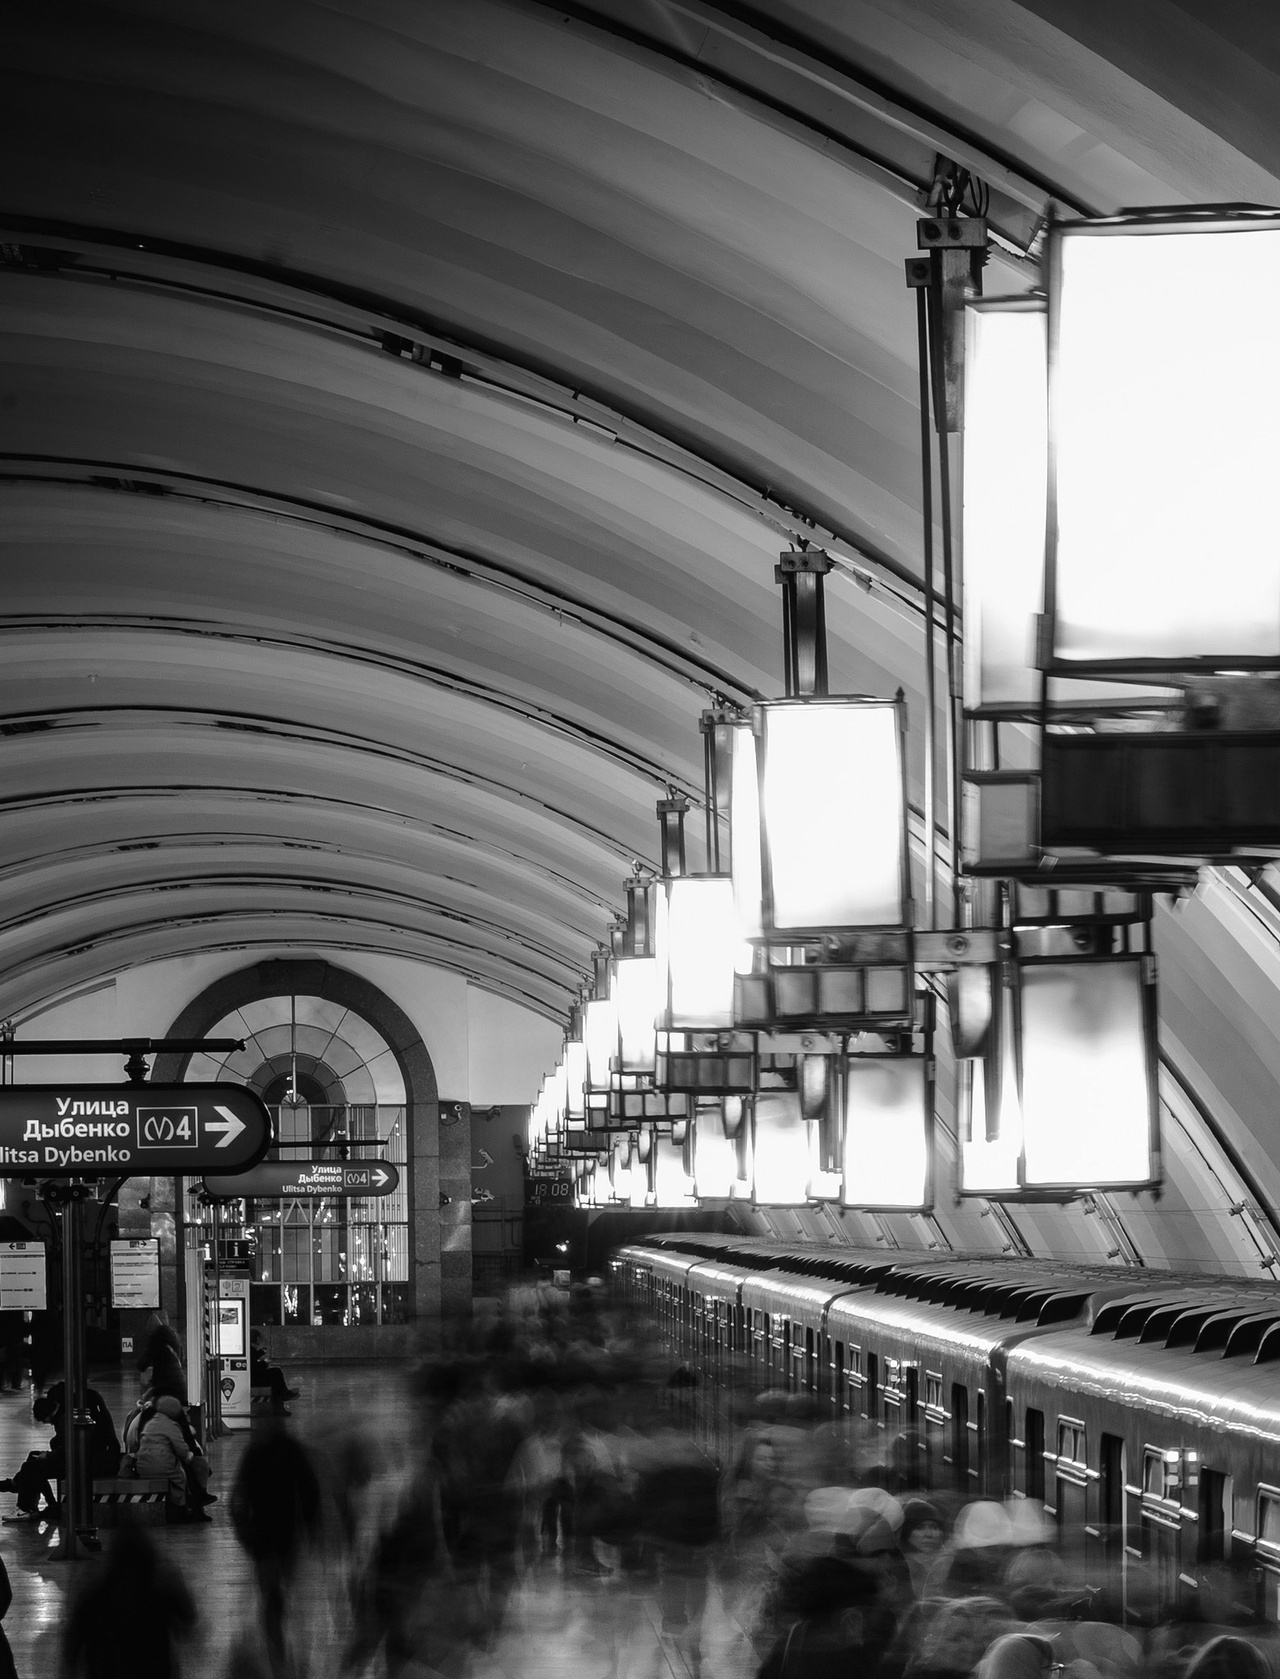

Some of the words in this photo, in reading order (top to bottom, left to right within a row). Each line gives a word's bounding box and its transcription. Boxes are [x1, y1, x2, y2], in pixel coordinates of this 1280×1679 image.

[56, 1097, 130, 1118] Улица
[23, 1118, 131, 1141] Дыбенко
[45, 1145, 131, 1167] Dybenko
[312, 1165, 342, 1175] Улица
[298, 1174, 342, 1184] Дыбенко
[282, 1185, 305, 1193] Ulitsa
[307, 1185, 342, 1194] Dybenko
